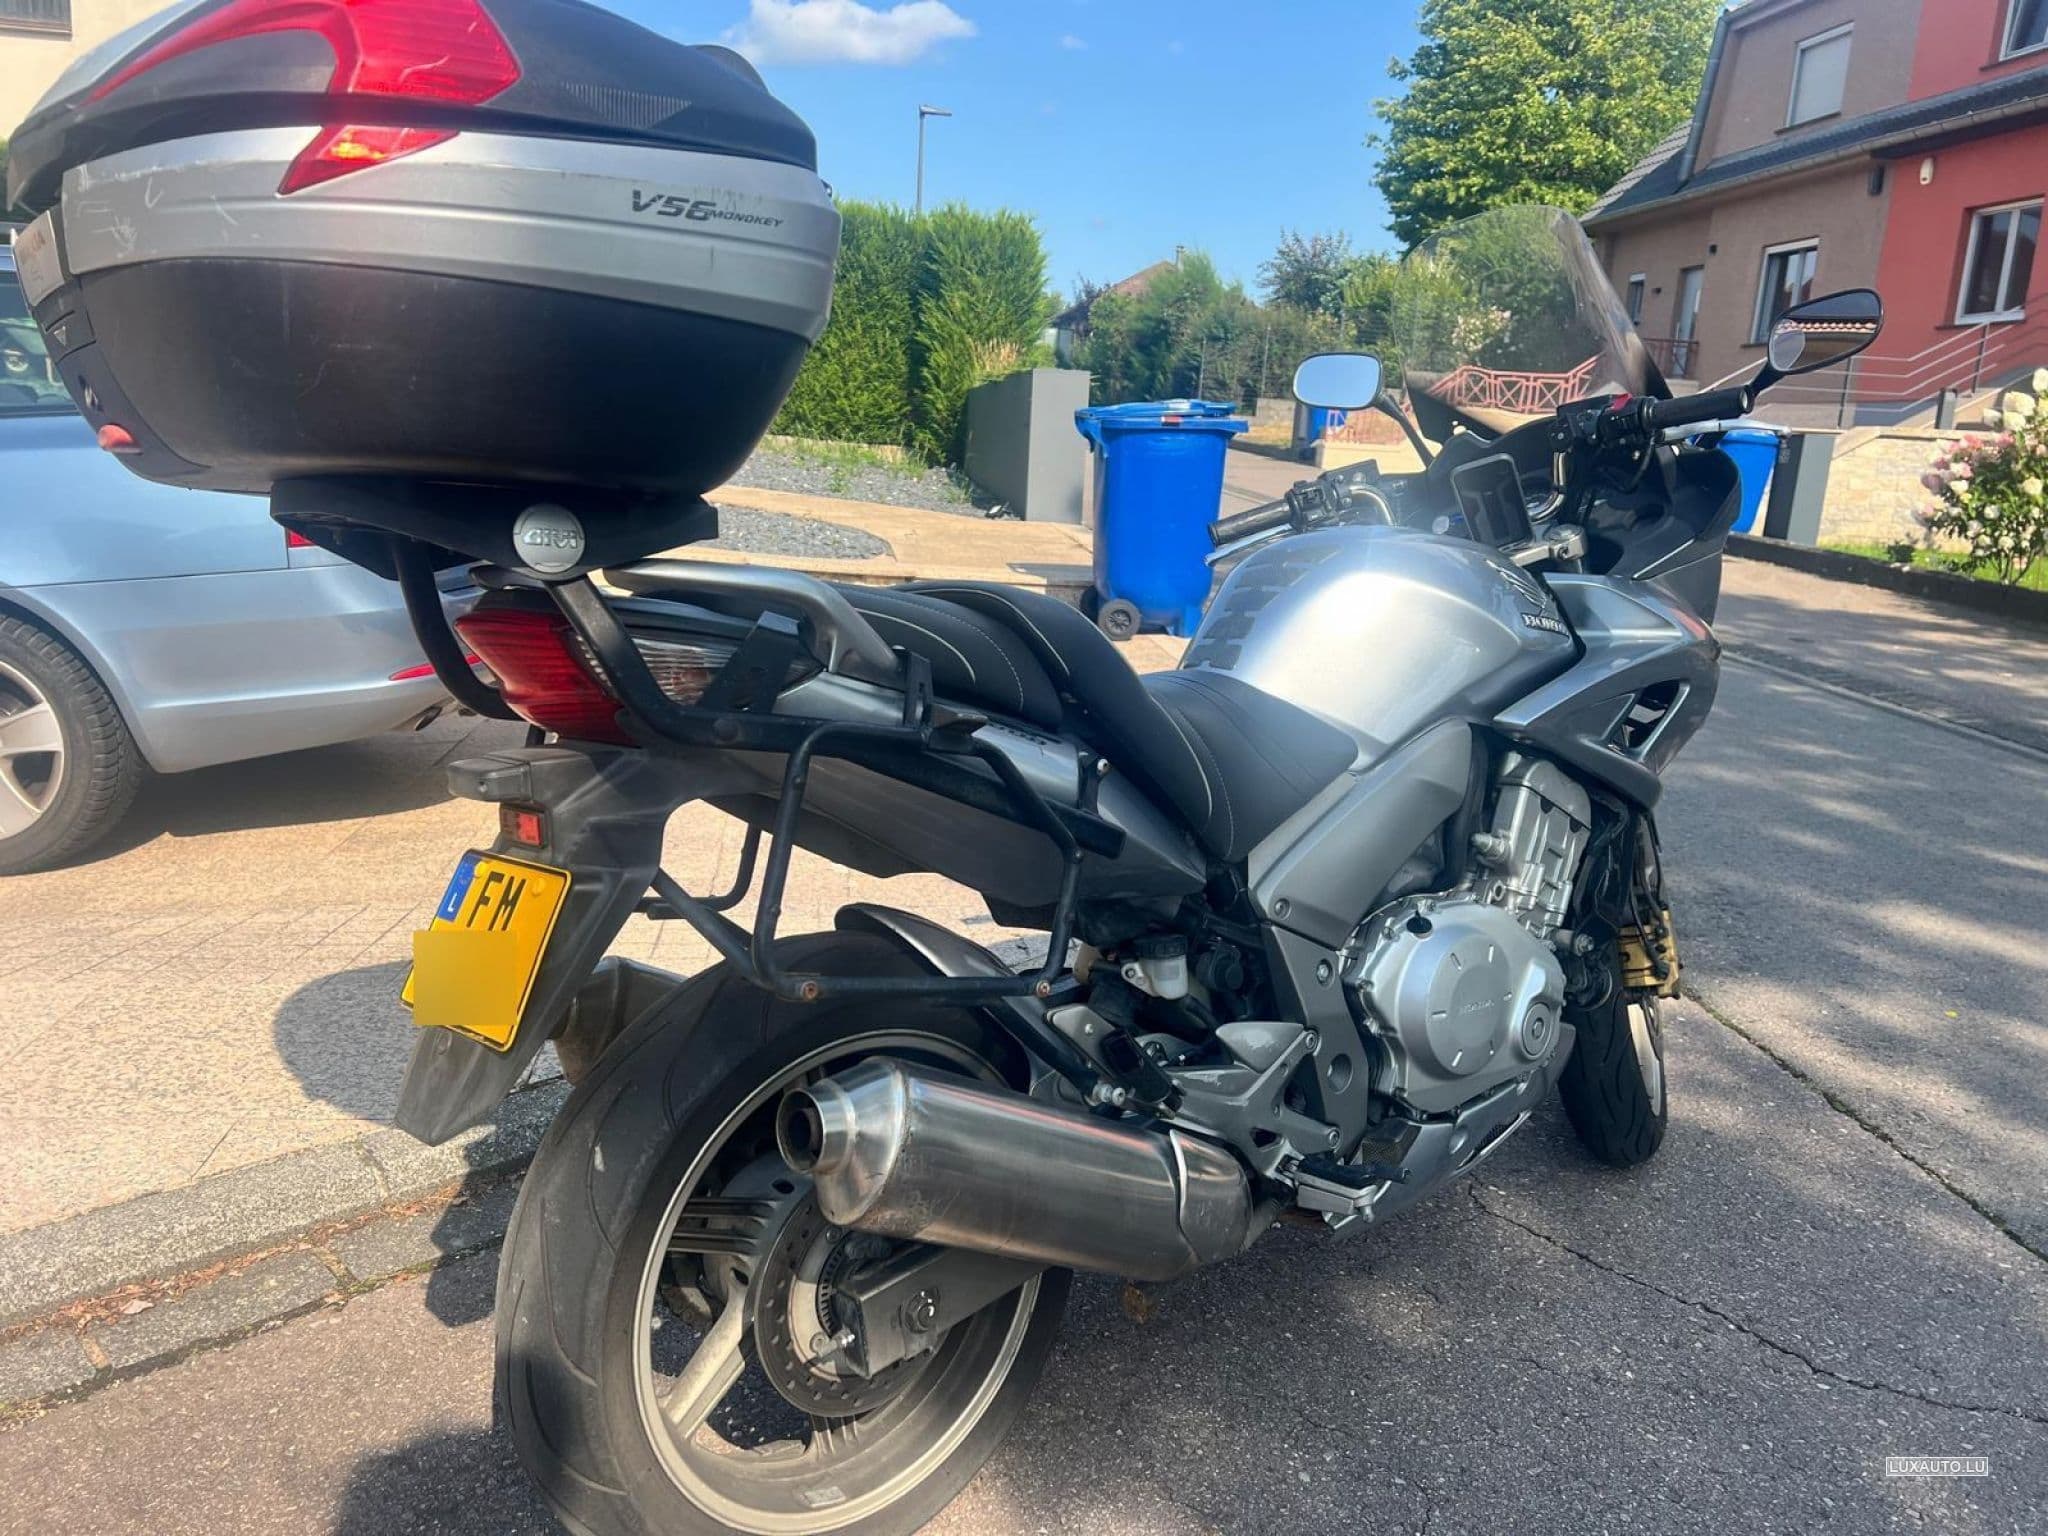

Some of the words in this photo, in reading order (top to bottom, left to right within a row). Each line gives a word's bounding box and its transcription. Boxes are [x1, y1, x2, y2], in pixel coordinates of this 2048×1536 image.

[632, 190, 716, 221] V56
[707, 209, 784, 227] MONOKEY
[466, 871, 527, 931] FM
